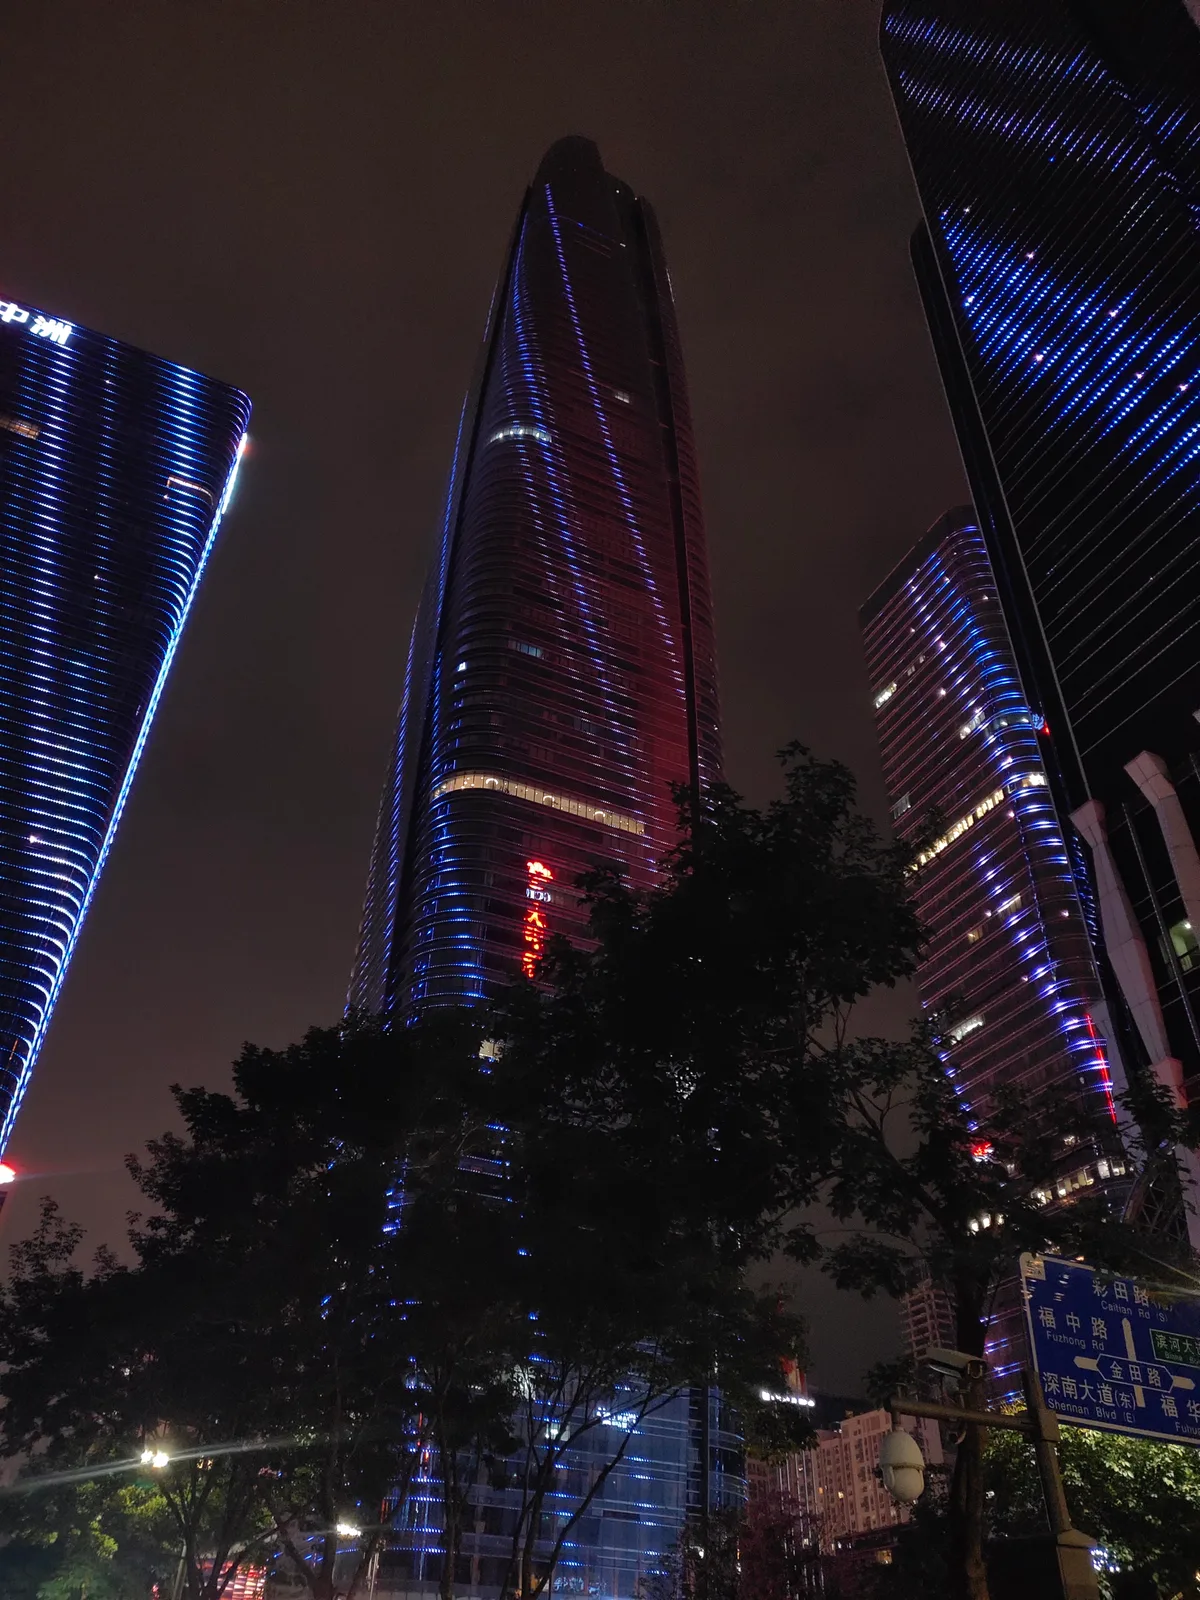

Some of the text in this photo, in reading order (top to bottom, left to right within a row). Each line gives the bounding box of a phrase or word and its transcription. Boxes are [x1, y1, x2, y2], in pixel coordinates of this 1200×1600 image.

[1038, 1306, 1108, 1340] 福中路
[1101, 1300, 1132, 1316] Caitian
[1138, 1308, 1150, 1319] Rd
[1046, 1331, 1105, 1351] Fuzhong Rd
[1109, 1361, 1162, 1388] 金田路
[1047, 1397, 1136, 1424] Shennan Blvd (E)
